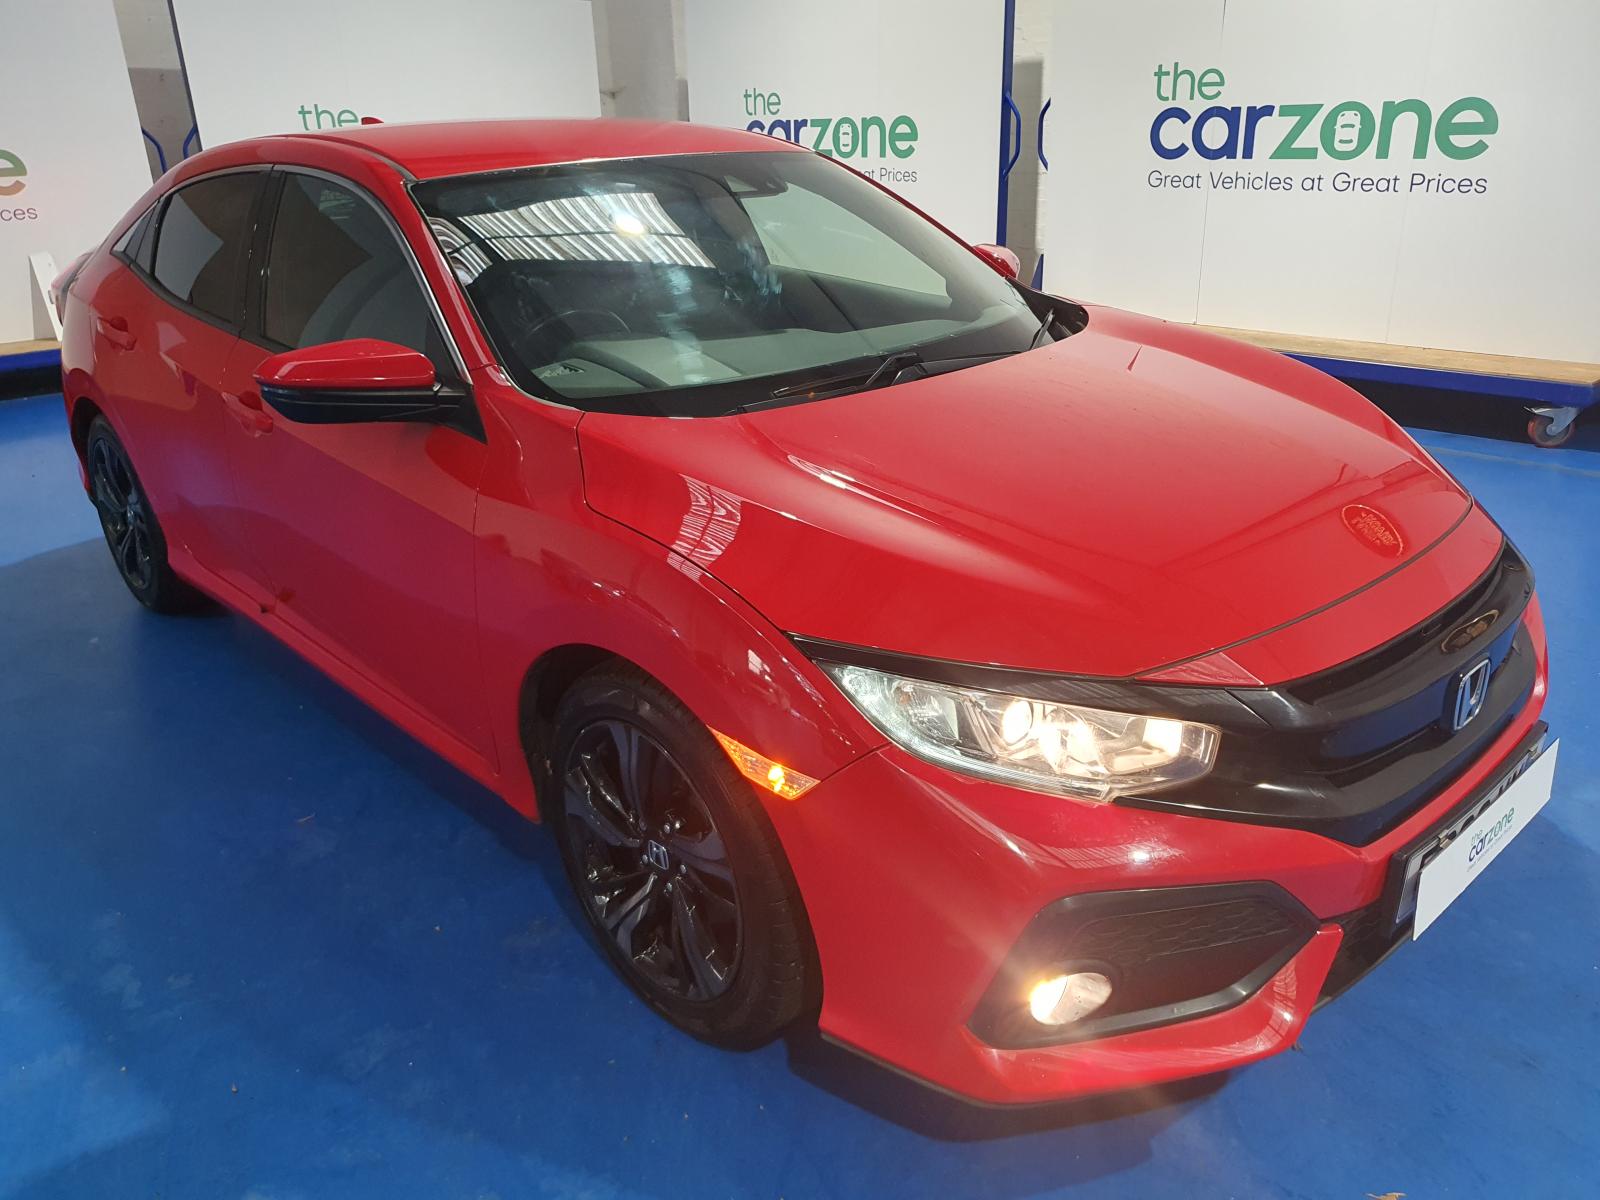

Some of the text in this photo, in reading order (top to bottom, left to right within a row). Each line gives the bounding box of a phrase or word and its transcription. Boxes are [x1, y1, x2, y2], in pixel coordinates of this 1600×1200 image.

[1153, 62, 1225, 101] the
[743, 87, 781, 116] the
[297, 103, 359, 131] the
[1149, 96, 1499, 161] carzone
[879, 167, 918, 183] Prices
[1147, 169, 1488, 194] Great Vehicles at Great Prices
[1468, 807, 1515, 862] carzone
